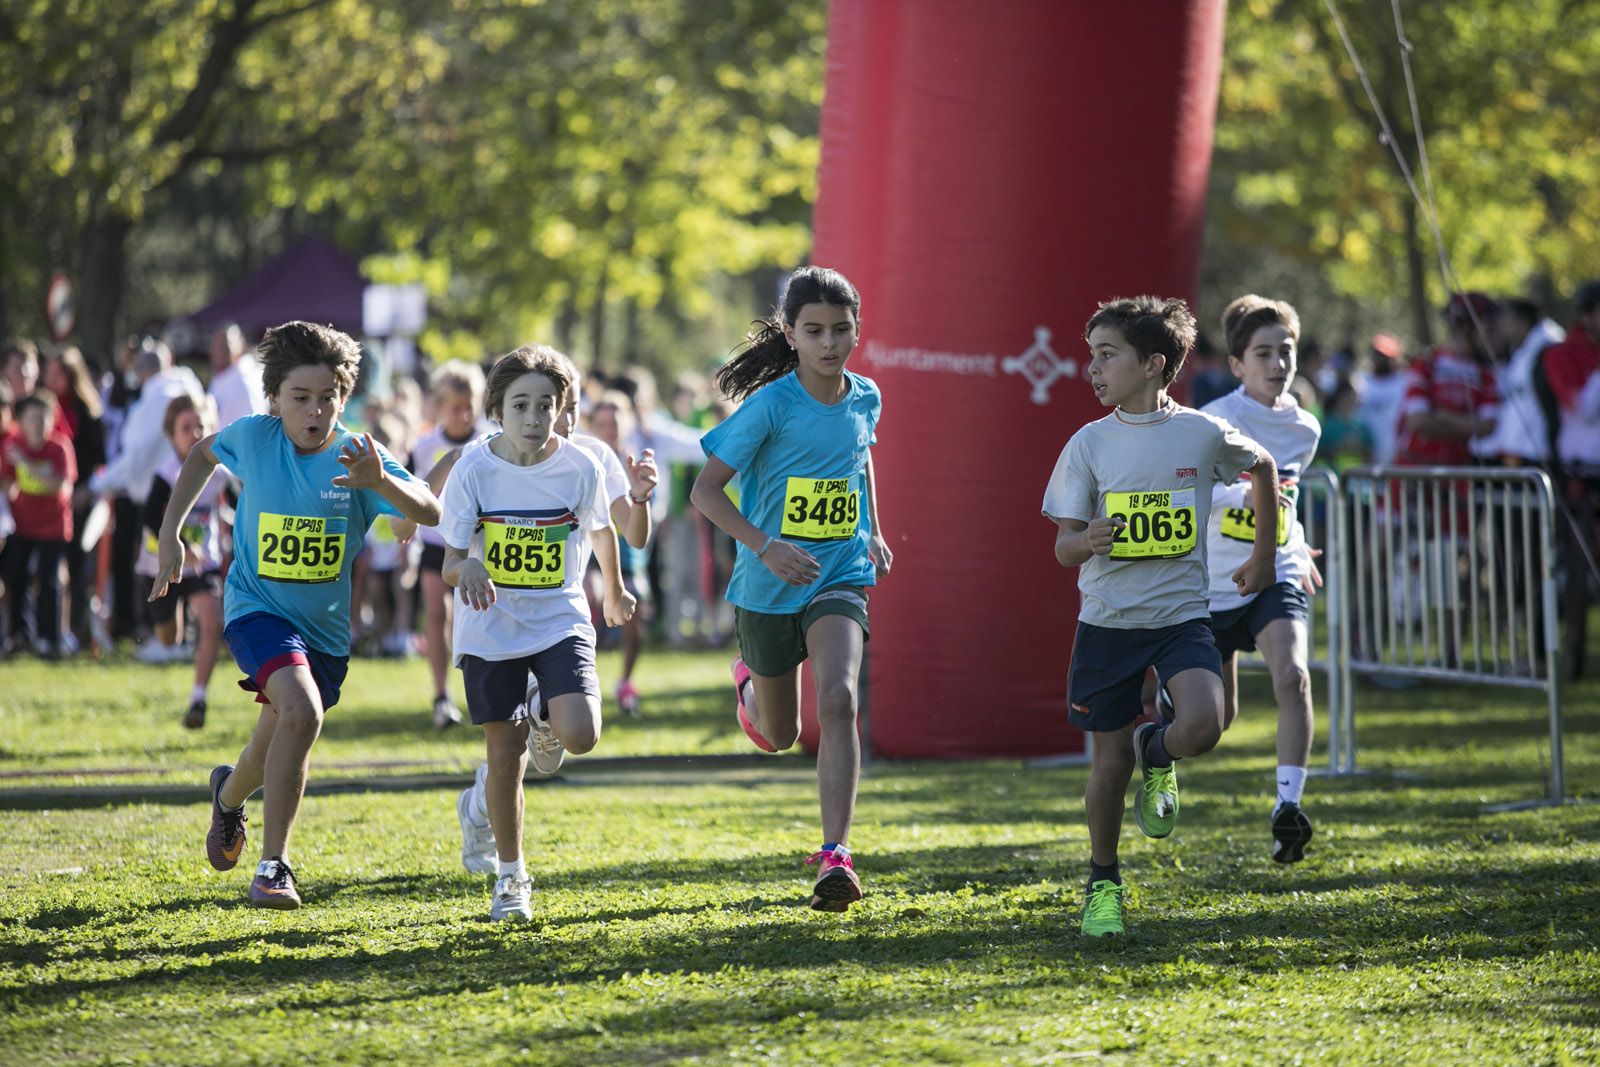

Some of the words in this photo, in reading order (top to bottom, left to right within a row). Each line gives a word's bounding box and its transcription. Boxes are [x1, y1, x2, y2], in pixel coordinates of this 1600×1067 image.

[866, 340, 996, 377] Ajuntament
[813, 481, 824, 494] 19
[1129, 494, 1140, 509] 19
[282, 518, 294, 531] 19
[787, 493, 857, 525] 3489
[505, 527, 516, 540] 19
[1111, 509, 1193, 543] 2063
[262, 533, 340, 567] 2955
[487, 541, 561, 572] 4853
